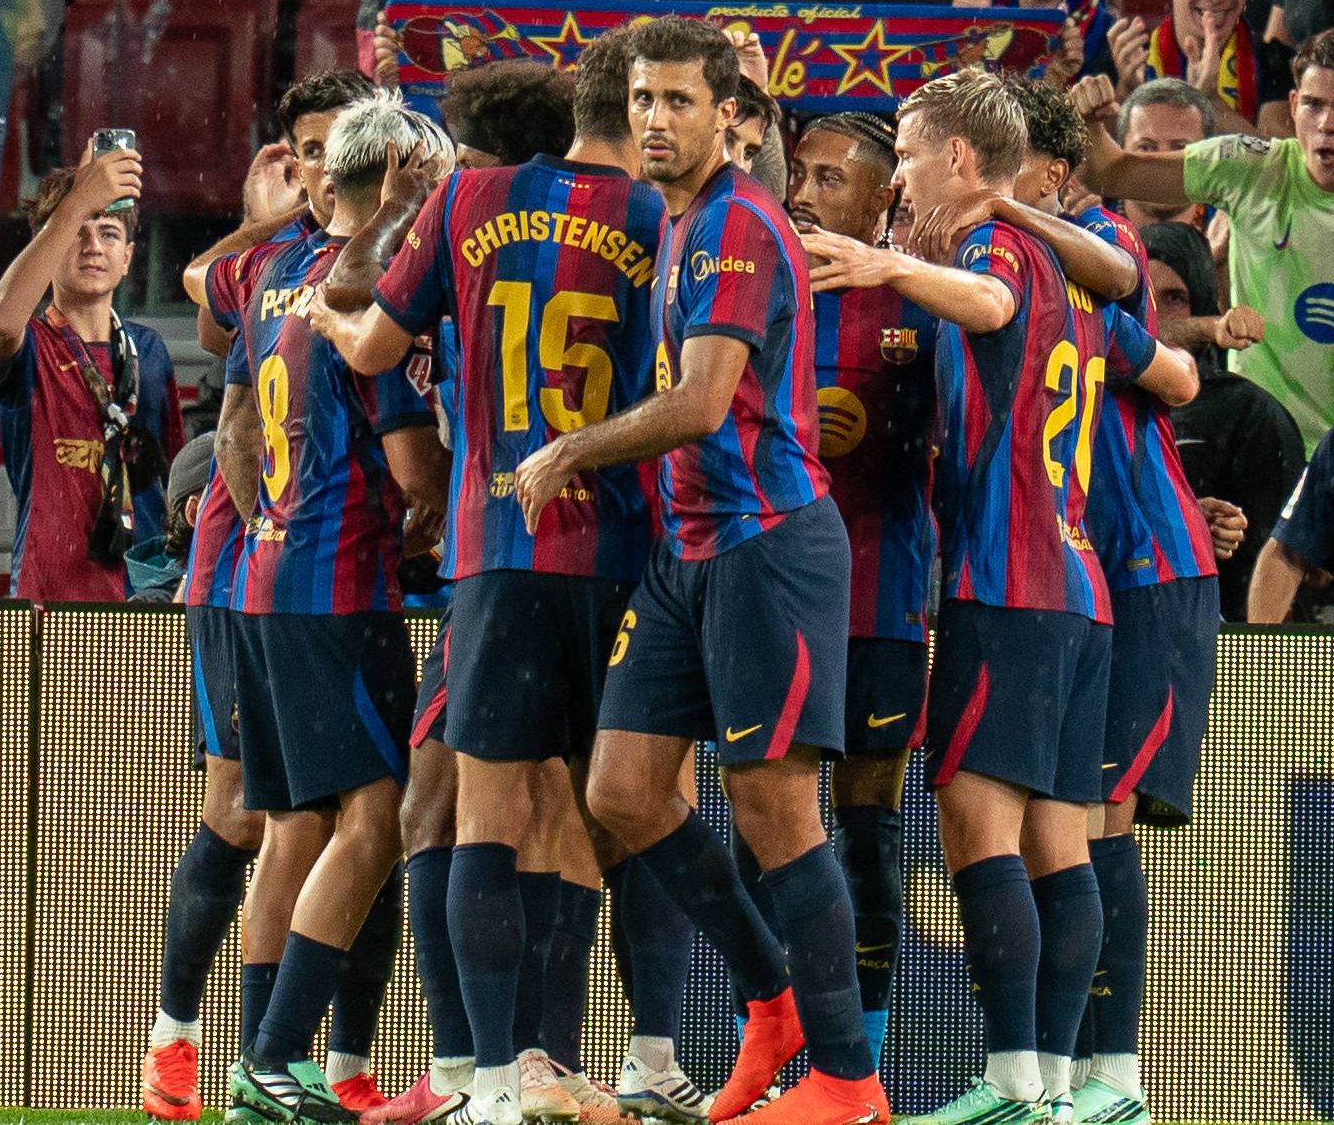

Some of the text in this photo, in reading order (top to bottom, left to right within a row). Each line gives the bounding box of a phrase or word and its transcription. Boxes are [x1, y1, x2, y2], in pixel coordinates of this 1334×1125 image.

[461, 211, 657, 289] CHRISTENSEN
[691, 250, 756, 281] Midea
[260, 284, 318, 322] PEDR
[486, 280, 620, 433] 15
[258, 354, 291, 503] 8
[608, 609, 637, 666] 6
